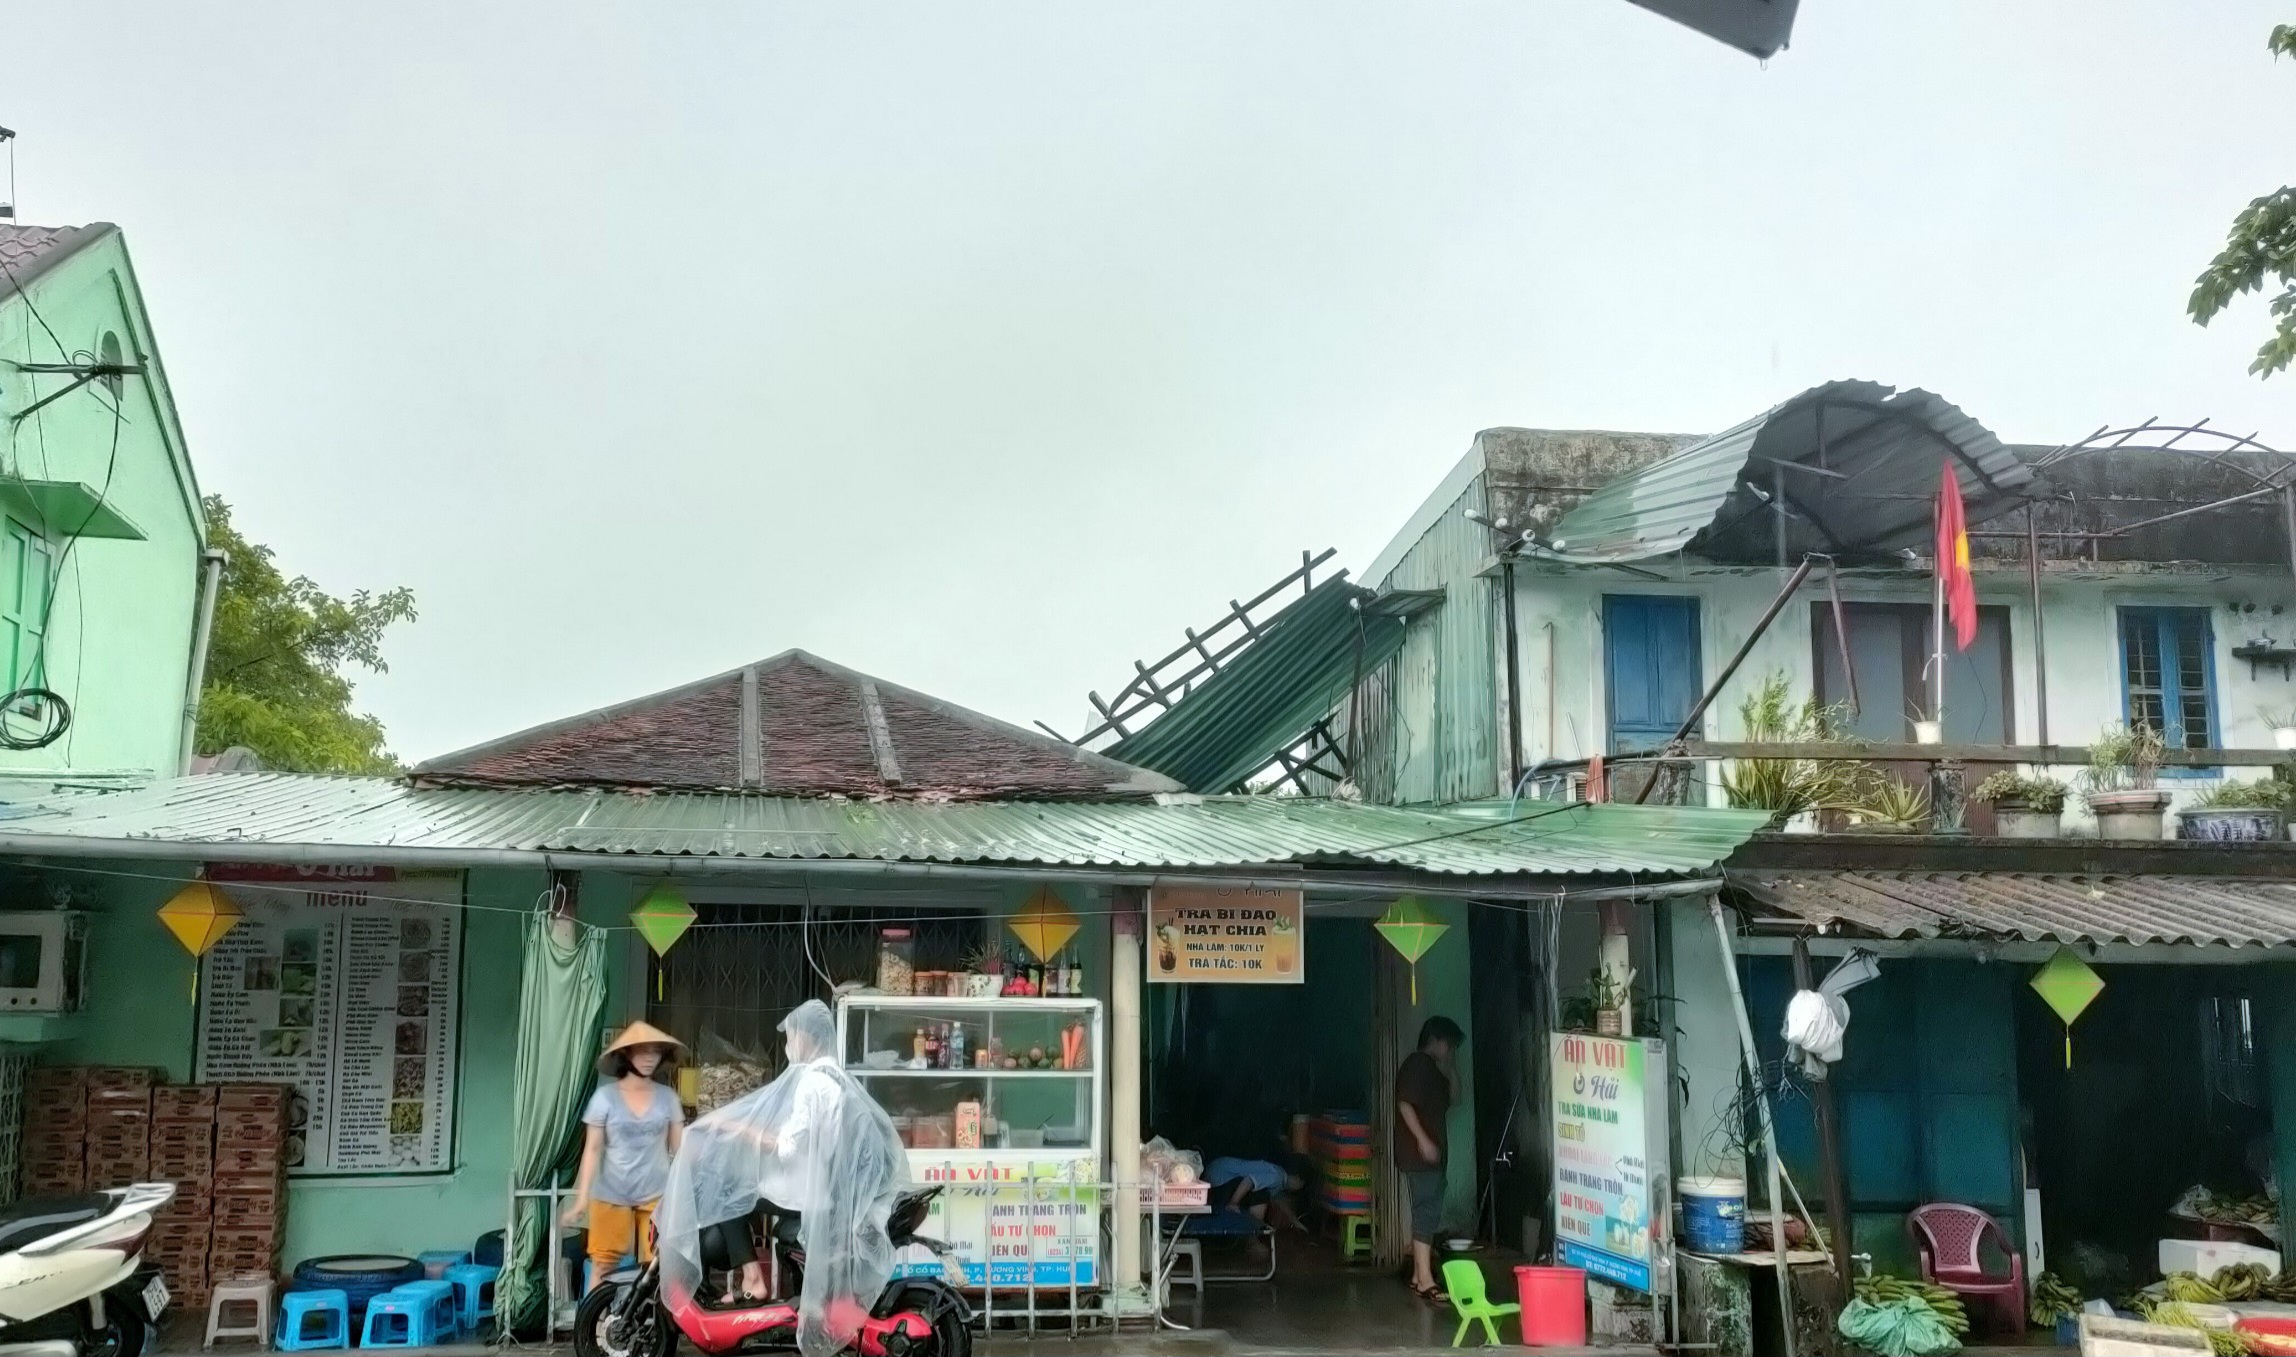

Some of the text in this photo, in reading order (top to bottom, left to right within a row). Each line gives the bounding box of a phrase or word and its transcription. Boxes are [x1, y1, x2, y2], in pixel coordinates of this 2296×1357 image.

[306, 889, 368, 908] menu
[1184, 924, 1267, 936] HẠT CHIA
[1230, 944, 1253, 952] 10K/1
[1243, 959, 1263, 969] 10K
[1577, 1219, 1591, 1237] QUE
